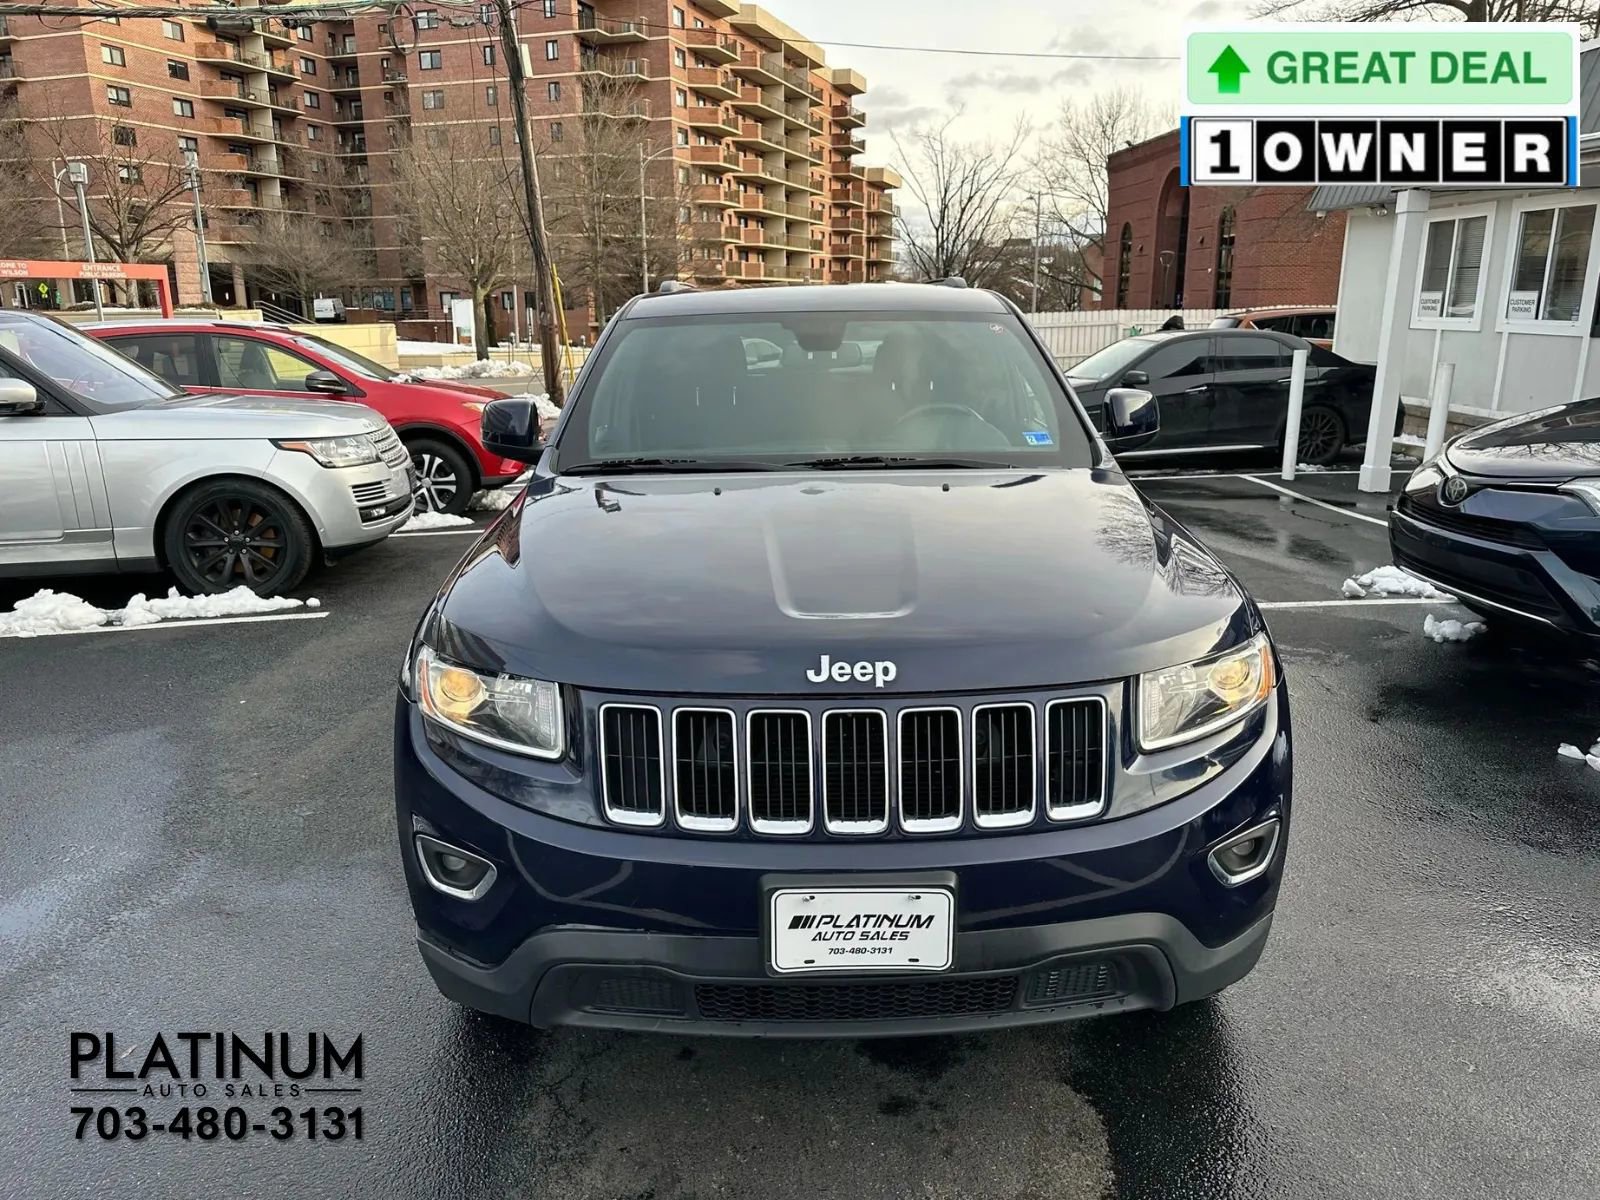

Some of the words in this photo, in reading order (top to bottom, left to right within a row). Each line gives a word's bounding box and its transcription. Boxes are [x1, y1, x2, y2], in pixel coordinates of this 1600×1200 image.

[82, 264, 121, 272] ENTRANCE
[806, 655, 897, 688] Jeep
[815, 914, 935, 929] PLATINUM
[811, 931, 855, 941] AUTO
[858, 931, 910, 941] SALES
[828, 947, 893, 955] 703-480-3131
